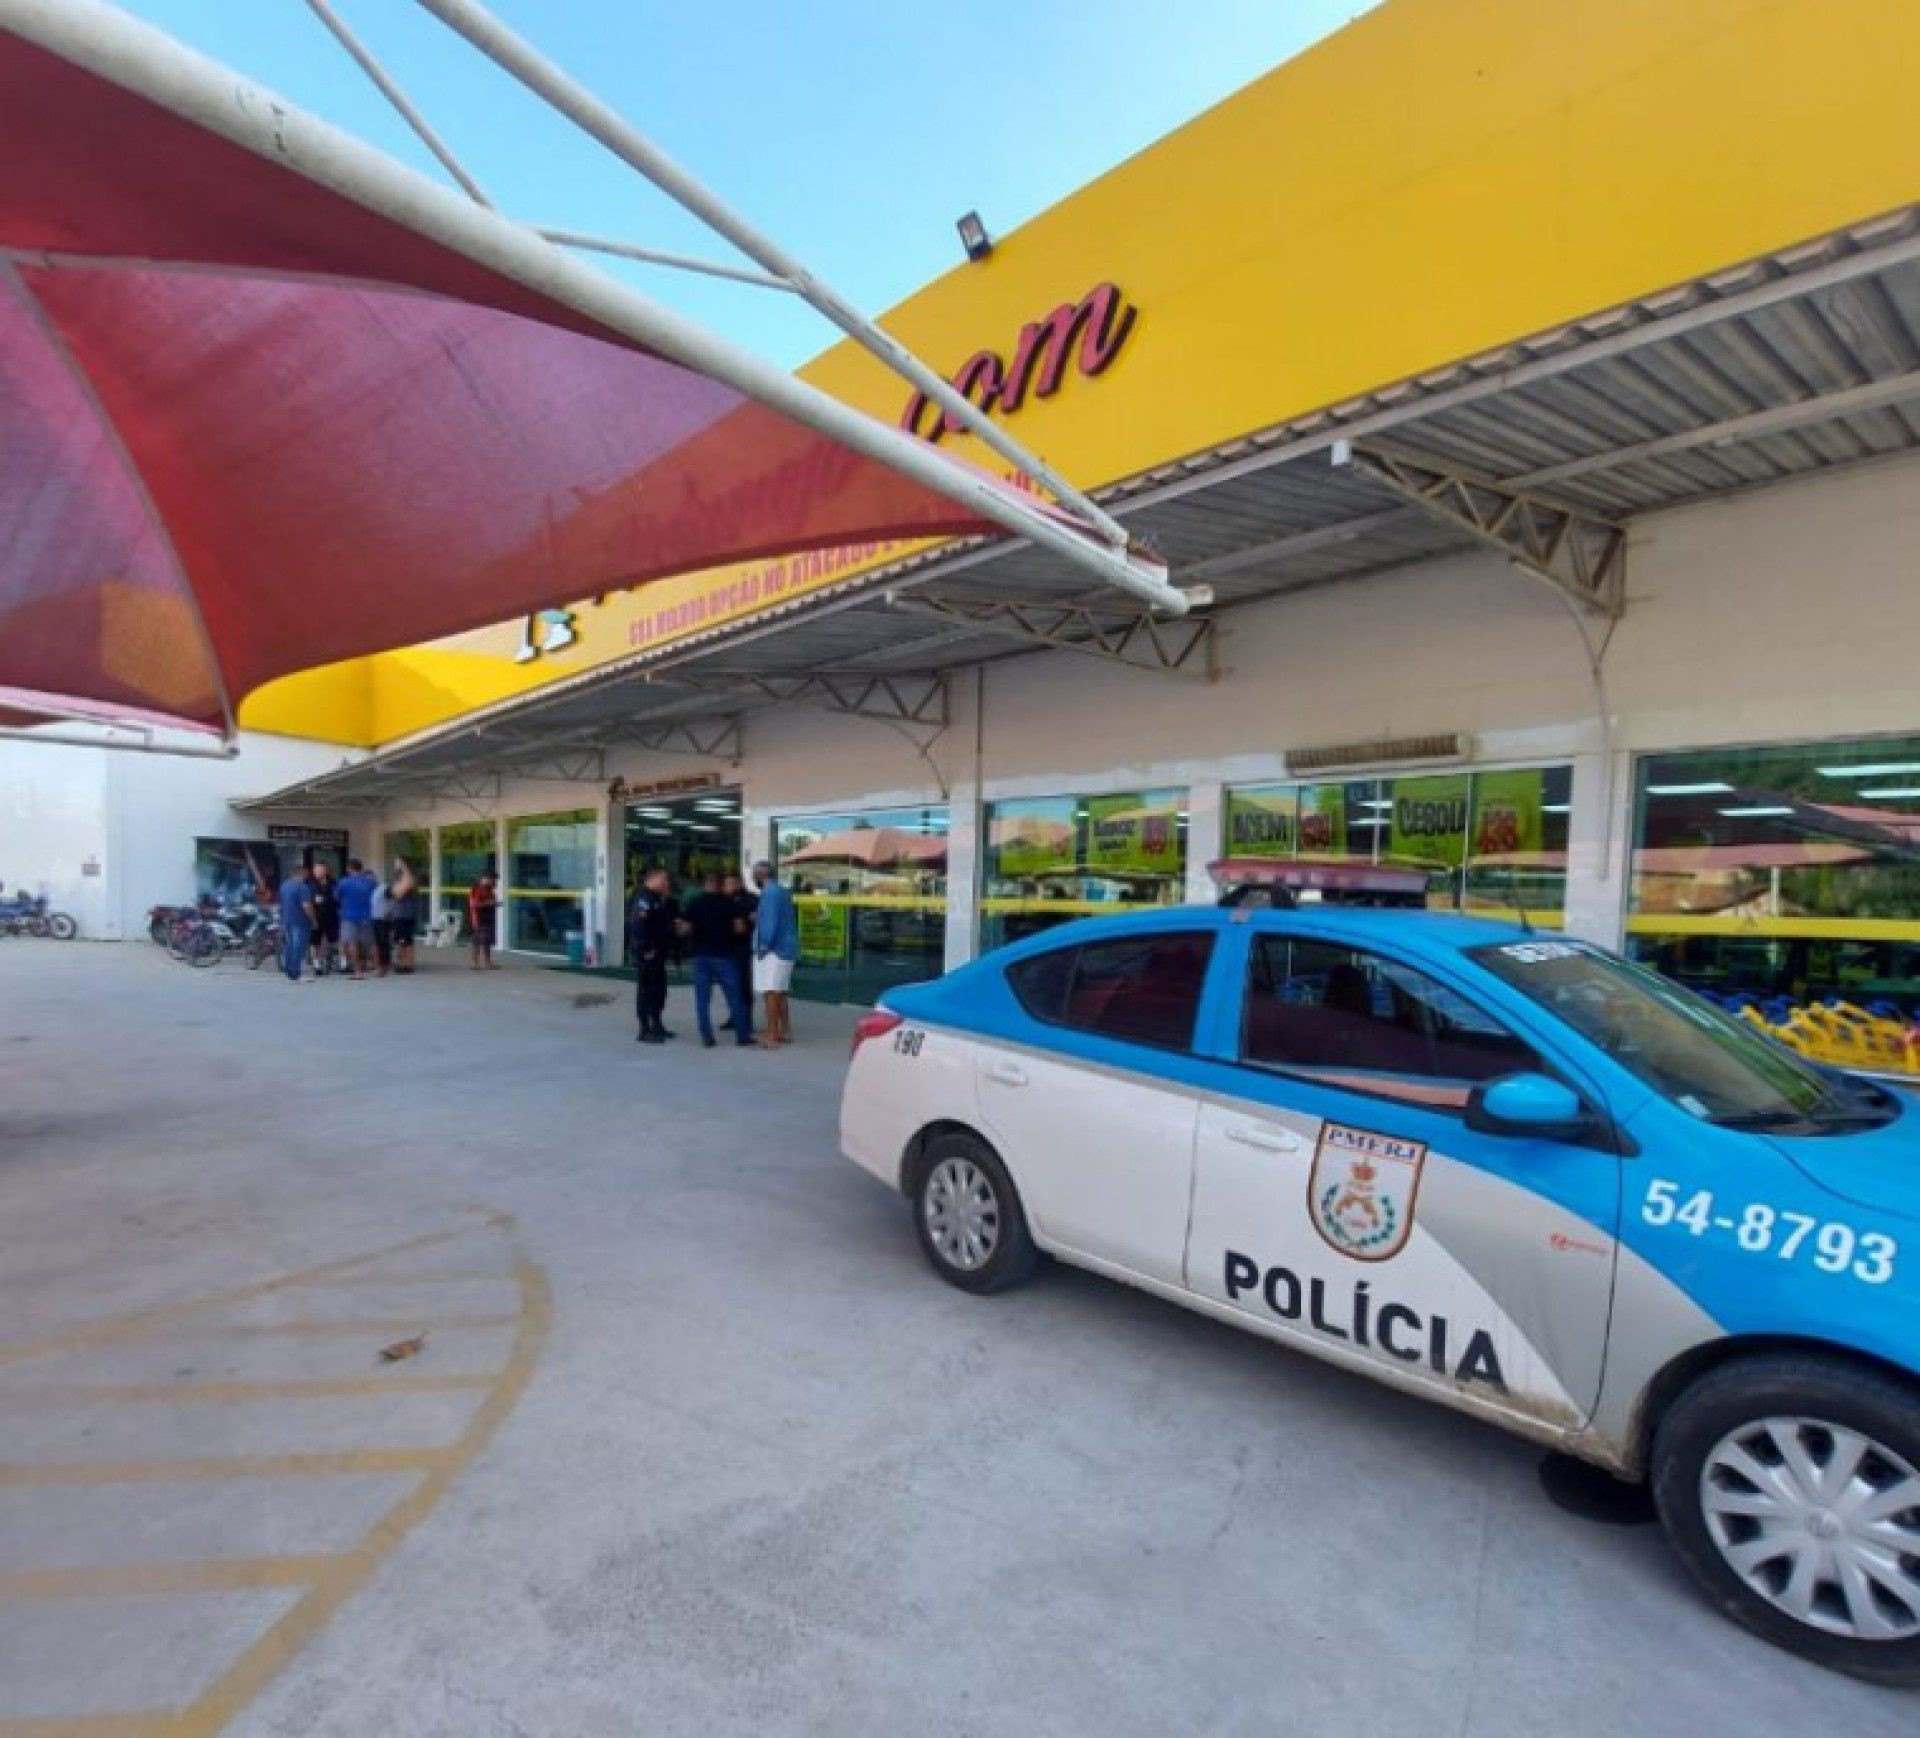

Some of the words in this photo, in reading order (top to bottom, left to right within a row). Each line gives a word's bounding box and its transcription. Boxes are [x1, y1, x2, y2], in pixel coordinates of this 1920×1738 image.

[763, 564, 786, 595] NO
[894, 1030, 926, 1057] 190
[1328, 1128, 1416, 1160] PMERJ
[1641, 1179, 1897, 1284] 54-8793
[1224, 1248, 1508, 1397] POLÍCIA
